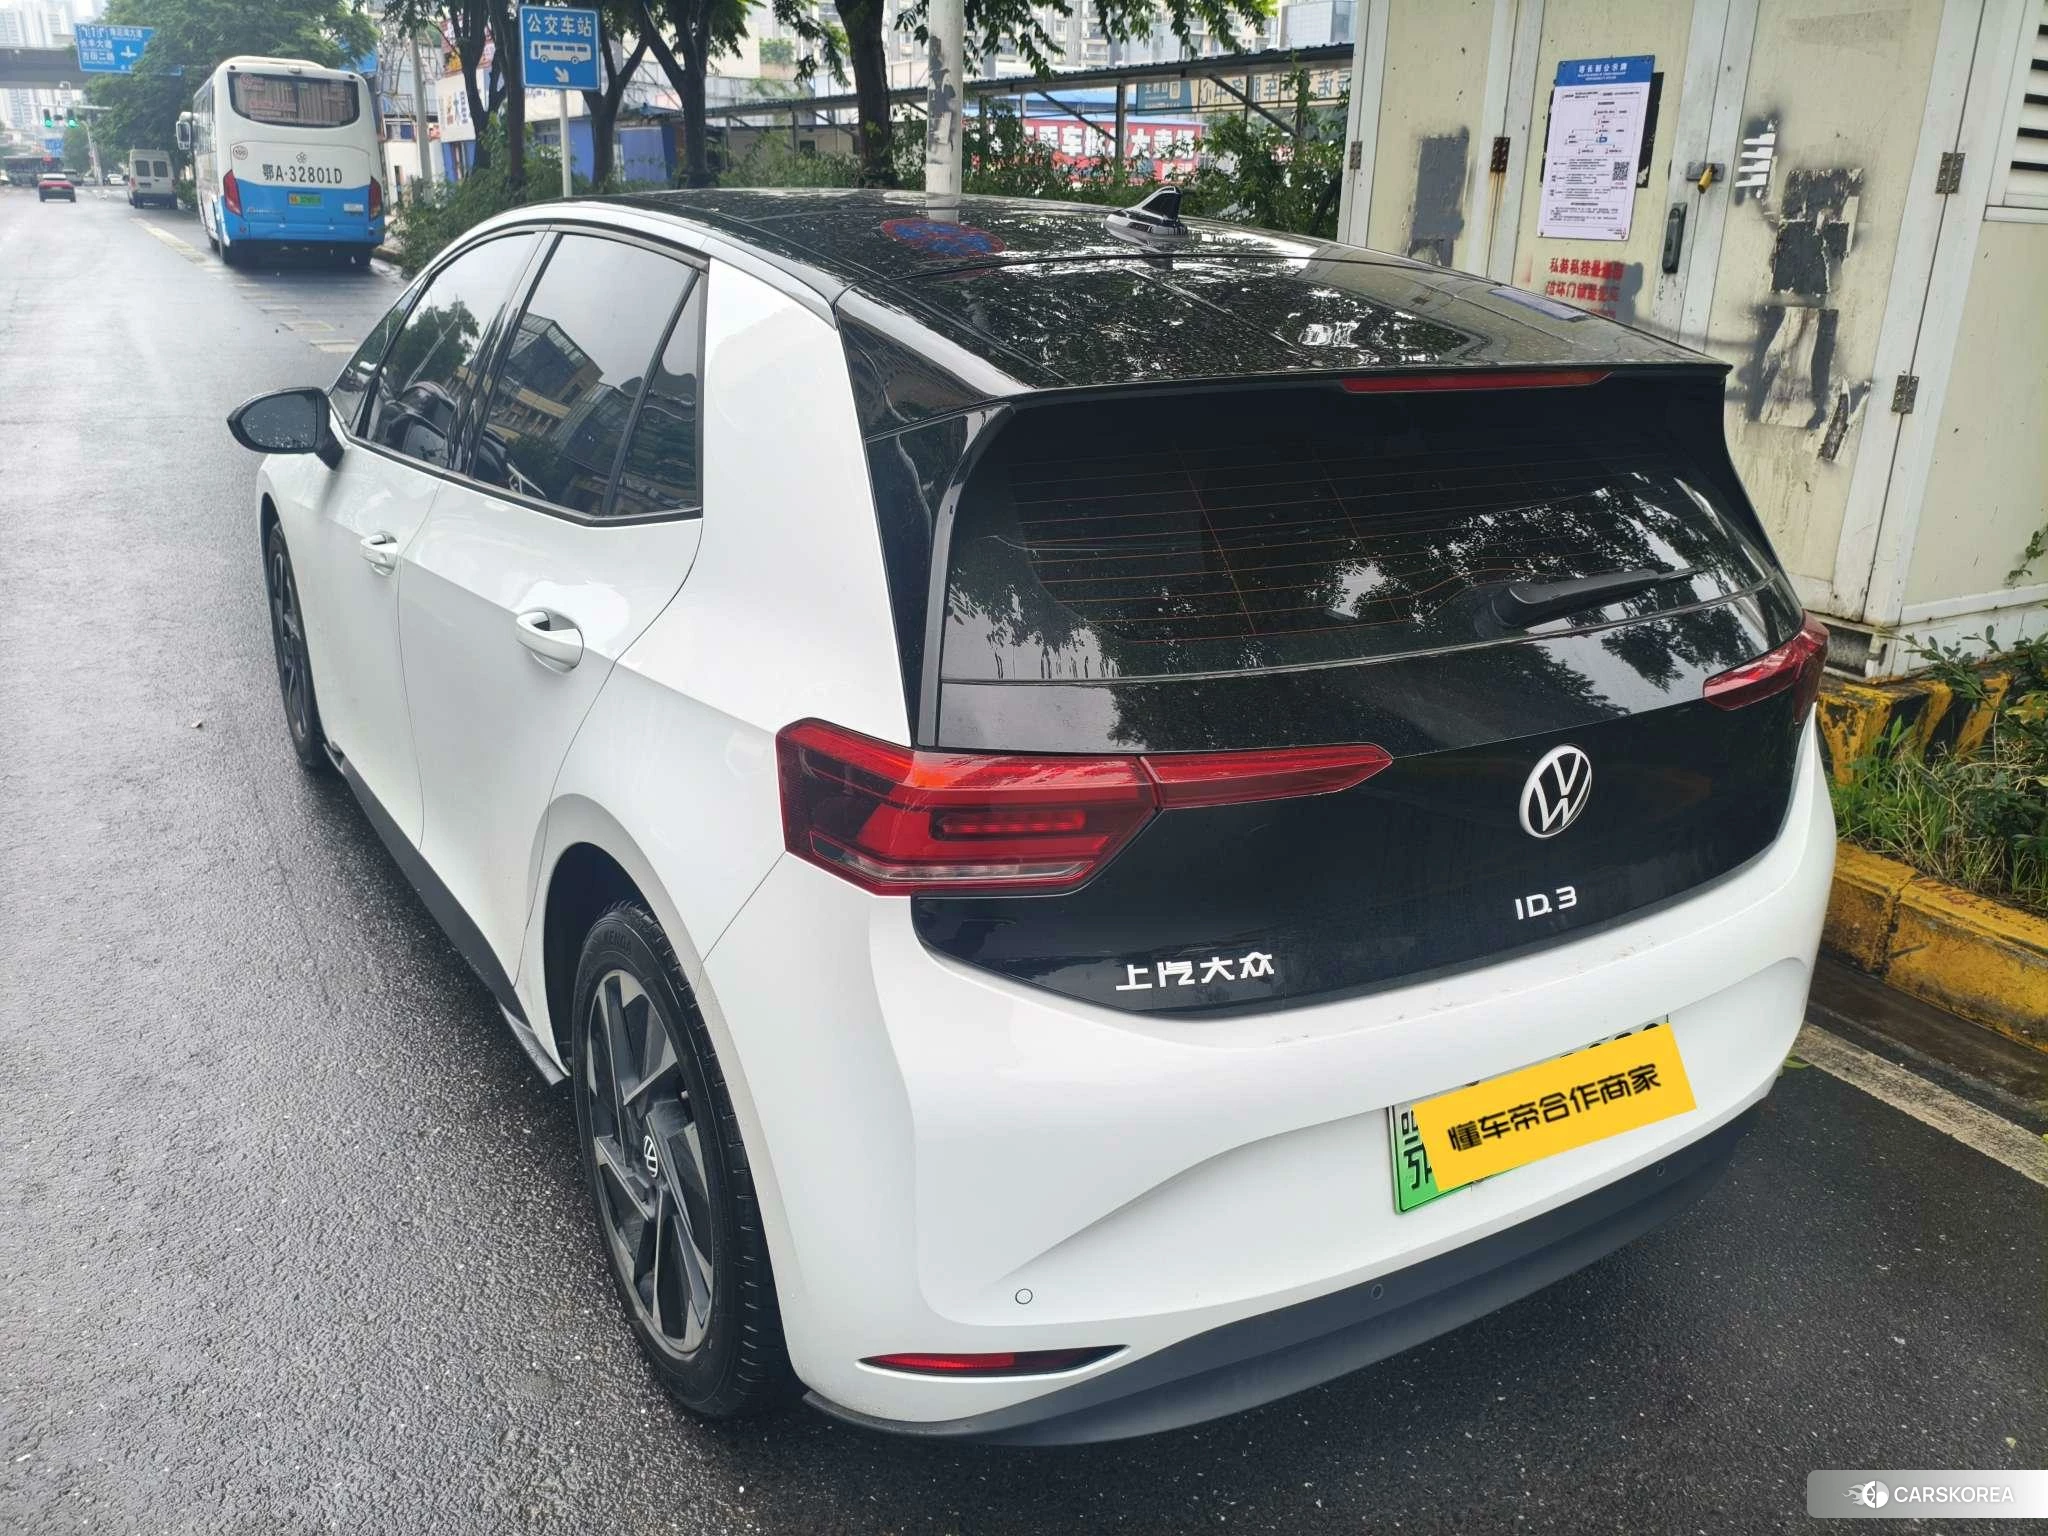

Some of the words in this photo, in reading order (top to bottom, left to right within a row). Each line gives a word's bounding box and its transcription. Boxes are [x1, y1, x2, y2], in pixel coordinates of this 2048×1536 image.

[527, 13, 592, 37] 公交车站
[1114, 951, 1276, 991] 上汽大众
